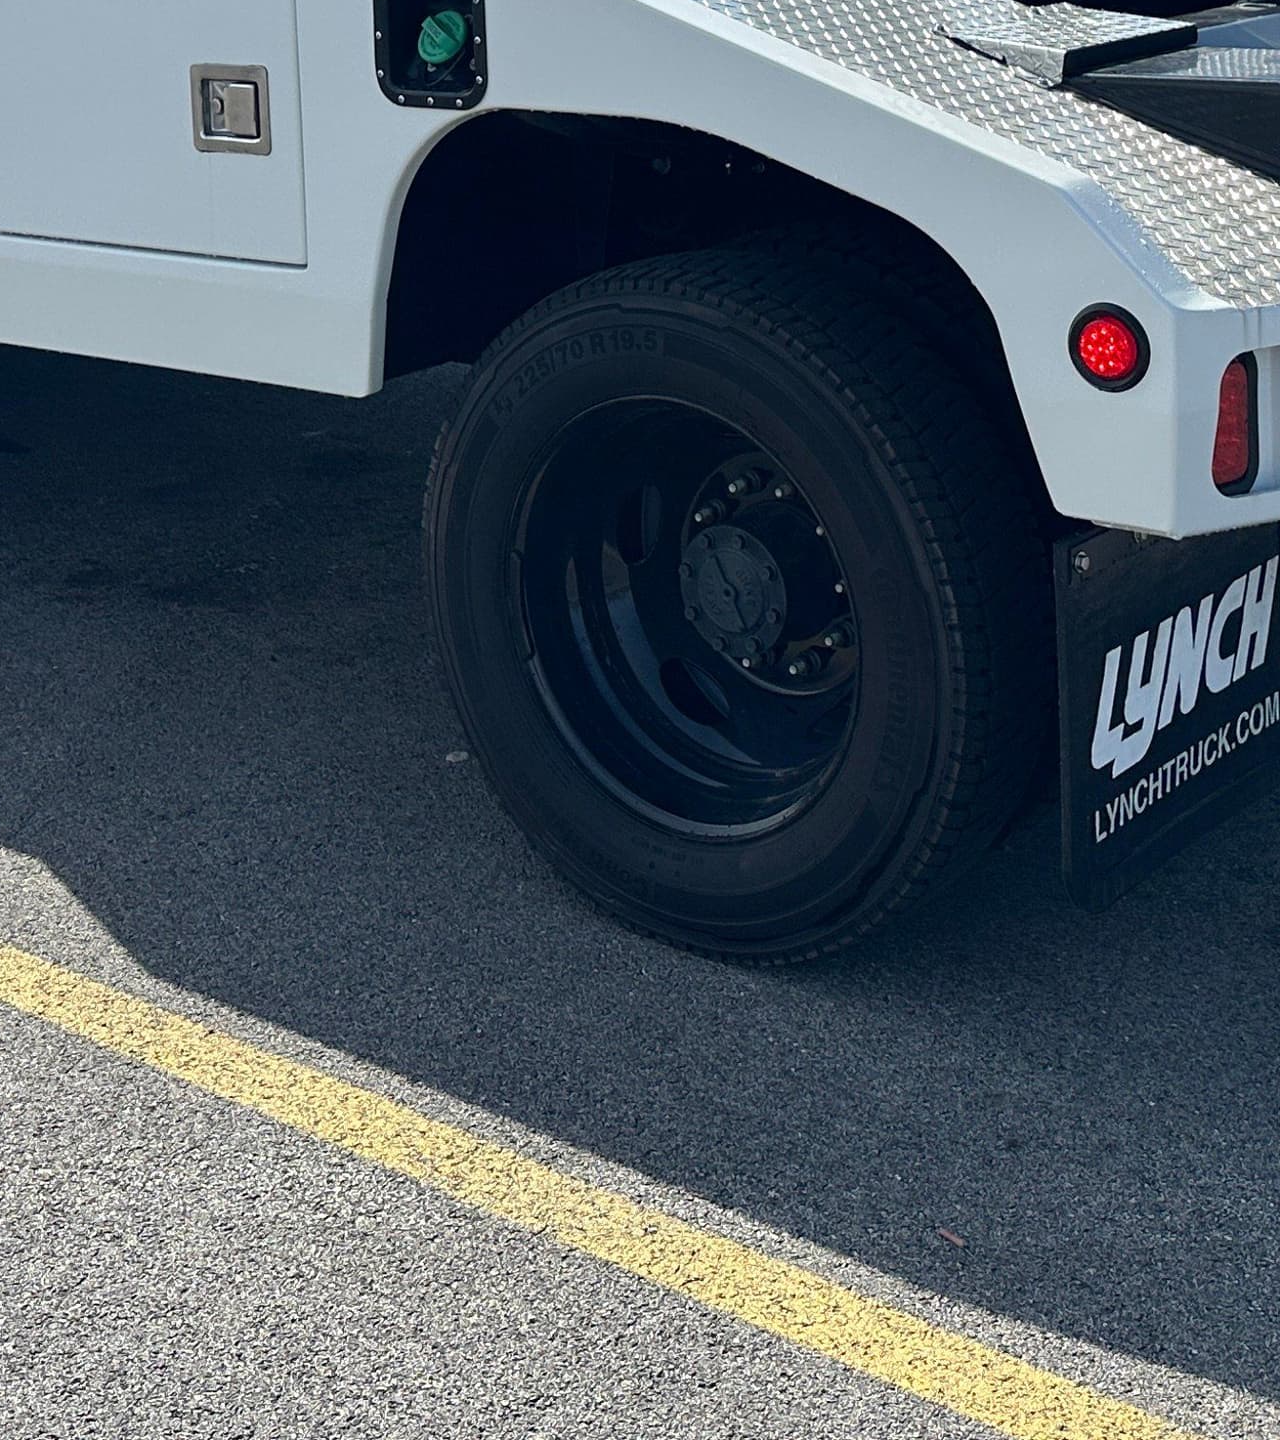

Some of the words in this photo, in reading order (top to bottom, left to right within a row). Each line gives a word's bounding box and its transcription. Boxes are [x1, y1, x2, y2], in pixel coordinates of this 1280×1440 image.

[513, 338, 585, 395] 225/70
[1091, 554, 1280, 780] LYNCH
[1094, 691, 1280, 844] LYNCHTRUCK.COM
